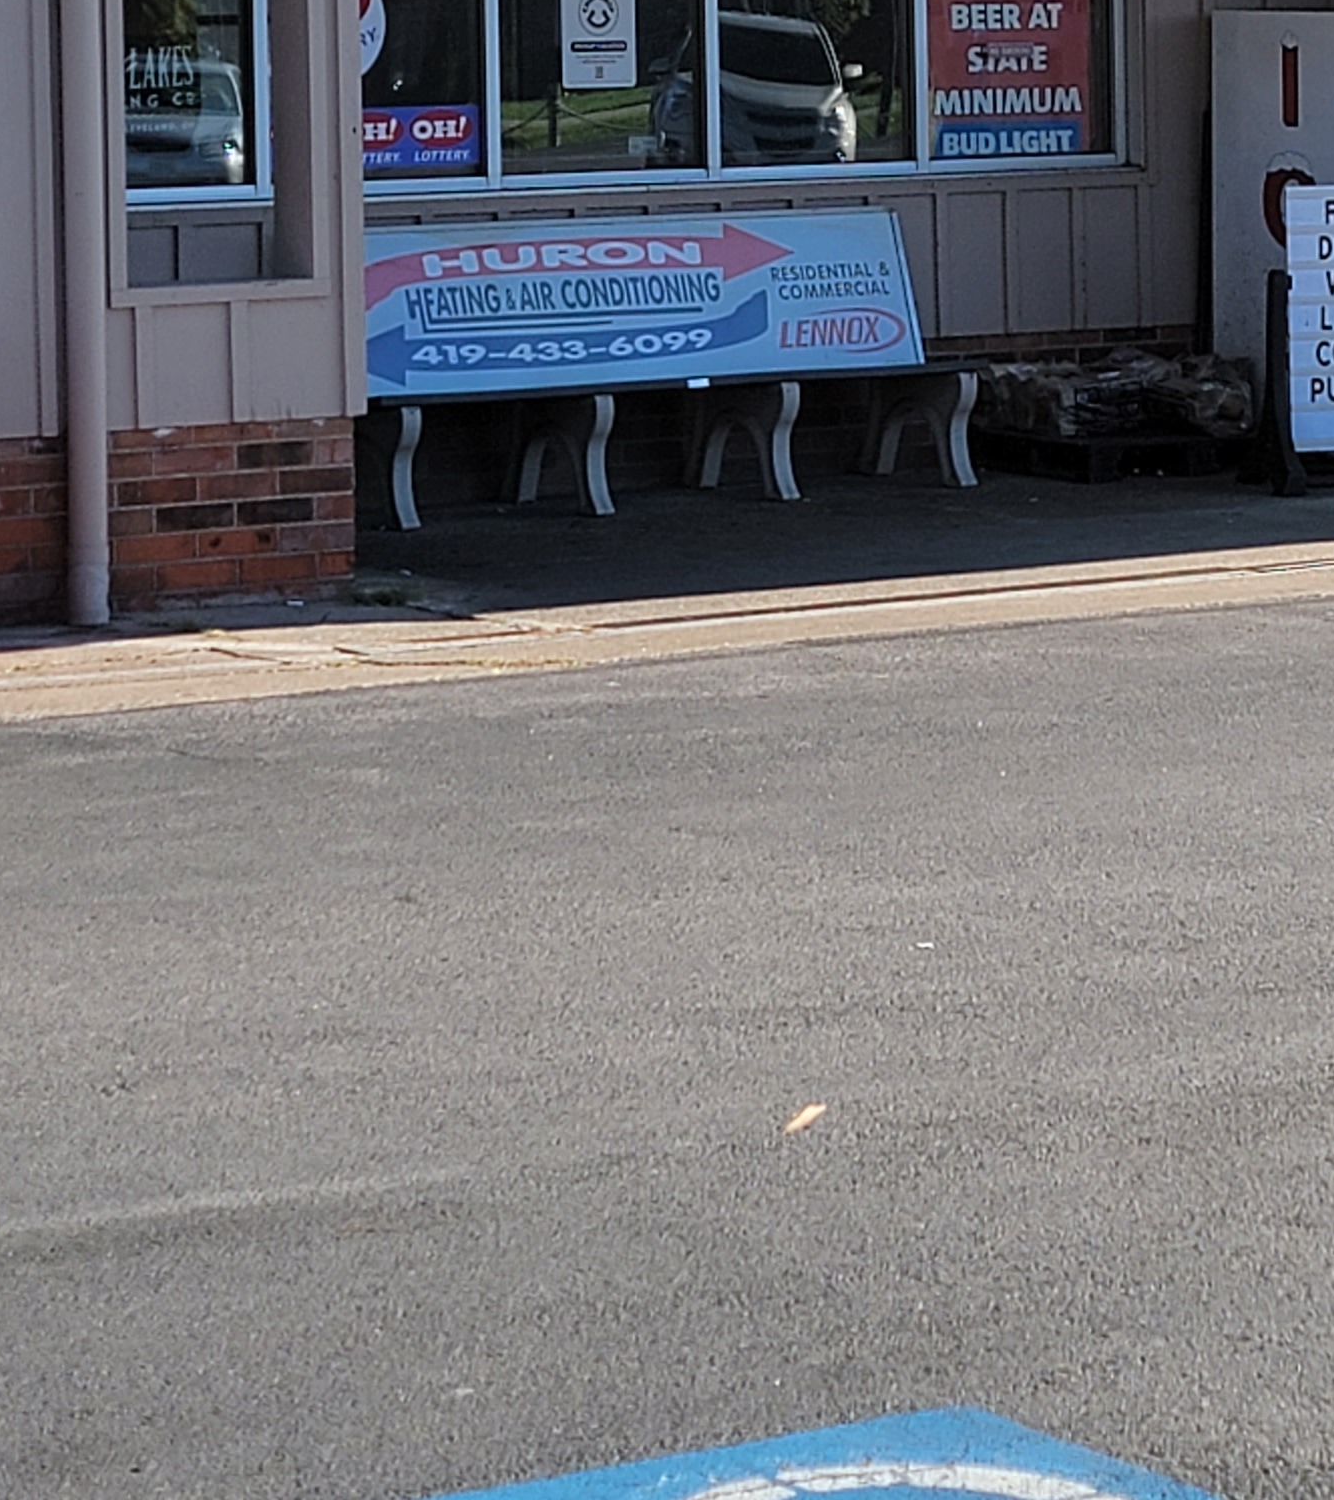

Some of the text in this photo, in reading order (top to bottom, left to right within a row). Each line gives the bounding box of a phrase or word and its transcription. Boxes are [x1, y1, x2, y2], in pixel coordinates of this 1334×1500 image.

[950, 2, 1063, 29] BEER AT
[967, 46, 1048, 73] STATE
[934, 88, 1082, 115] MINIMUM
[412, 115, 467, 140] OH!
[943, 130, 1073, 155] BUD LIGHT
[414, 150, 470, 163] LOTTERY
[421, 241, 704, 278] HURON
[771, 262, 890, 281] RESIDENTIAL &
[405, 272, 720, 319] HEATING & AIR CONDITIONING
[779, 279, 890, 300] COMMERCIAL
[779, 315, 880, 349] LENNOX
[412, 328, 713, 367] 419-433-6099
